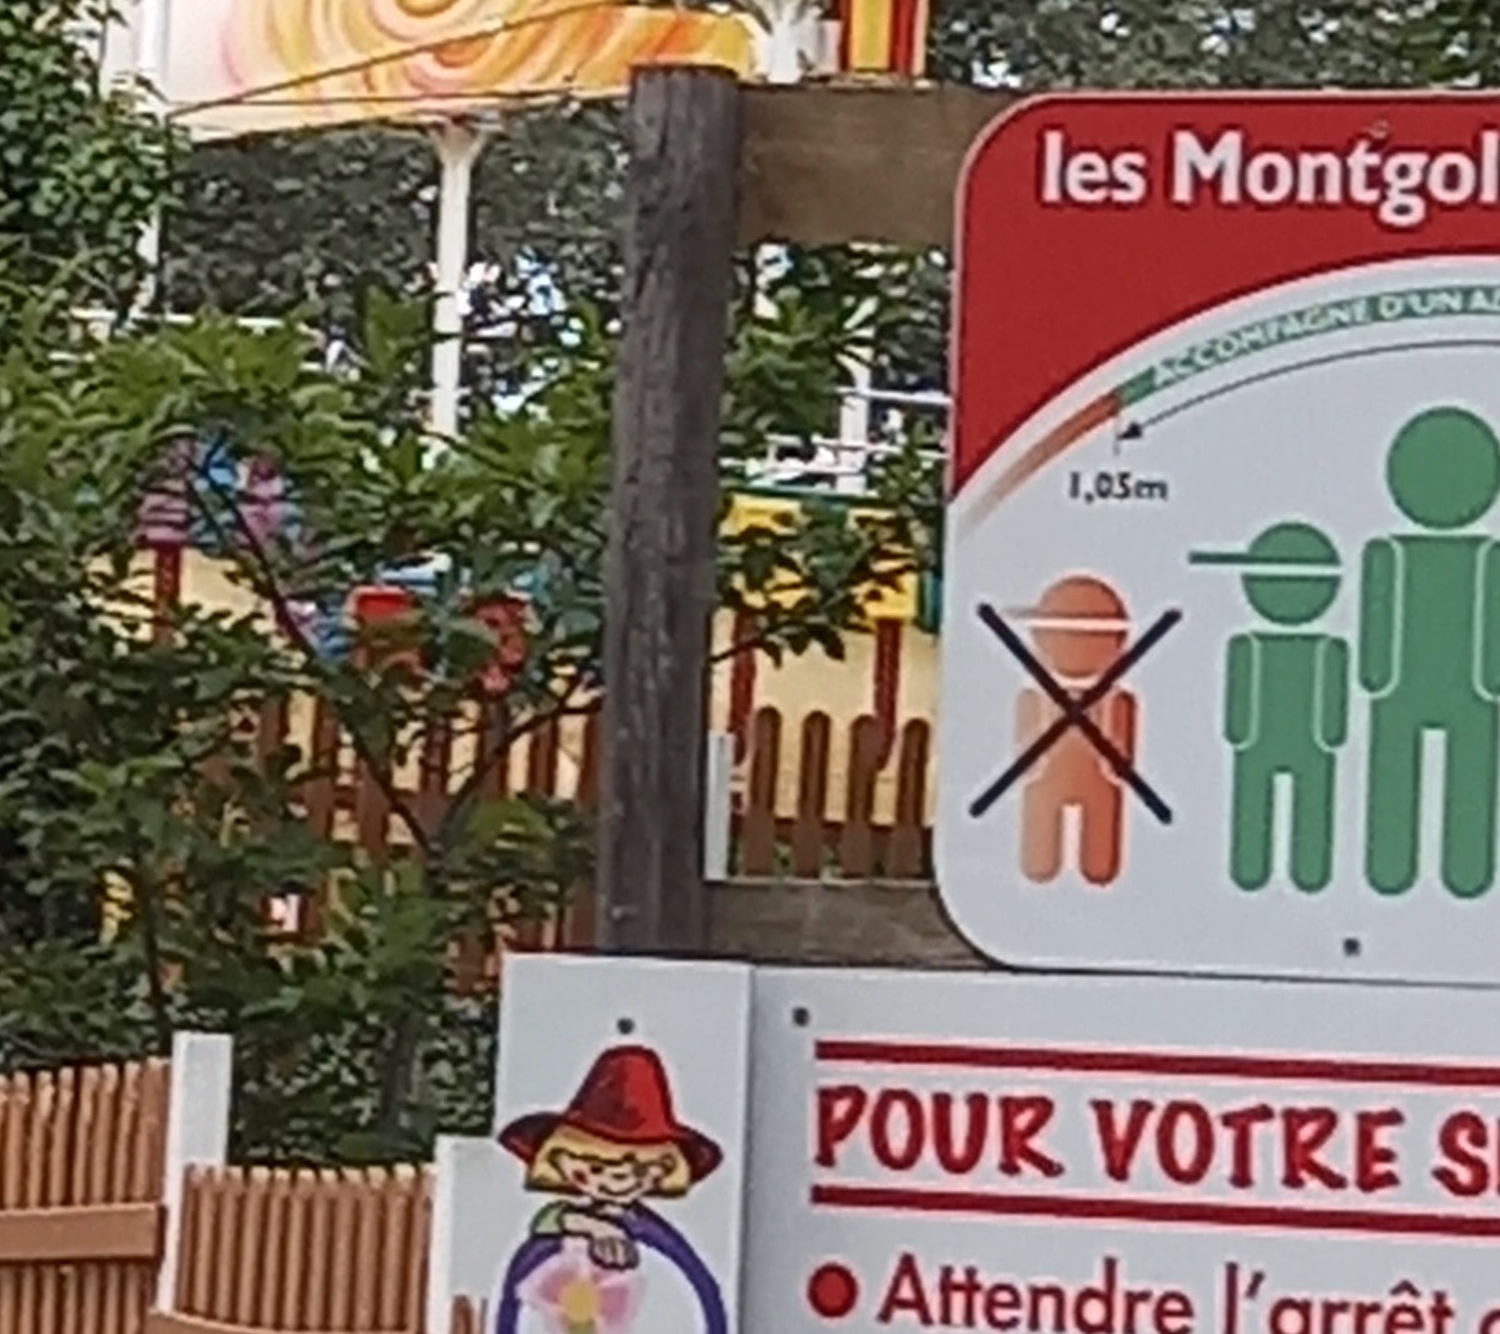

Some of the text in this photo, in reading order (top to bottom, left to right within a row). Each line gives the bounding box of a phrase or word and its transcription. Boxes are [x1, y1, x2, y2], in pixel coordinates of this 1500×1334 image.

[1042, 130, 1500, 226] les Montgol
[1068, 471, 1168, 503] 1,05m
[814, 1085, 1064, 1177] POUR
[1090, 1100, 1404, 1193] VOTRE
